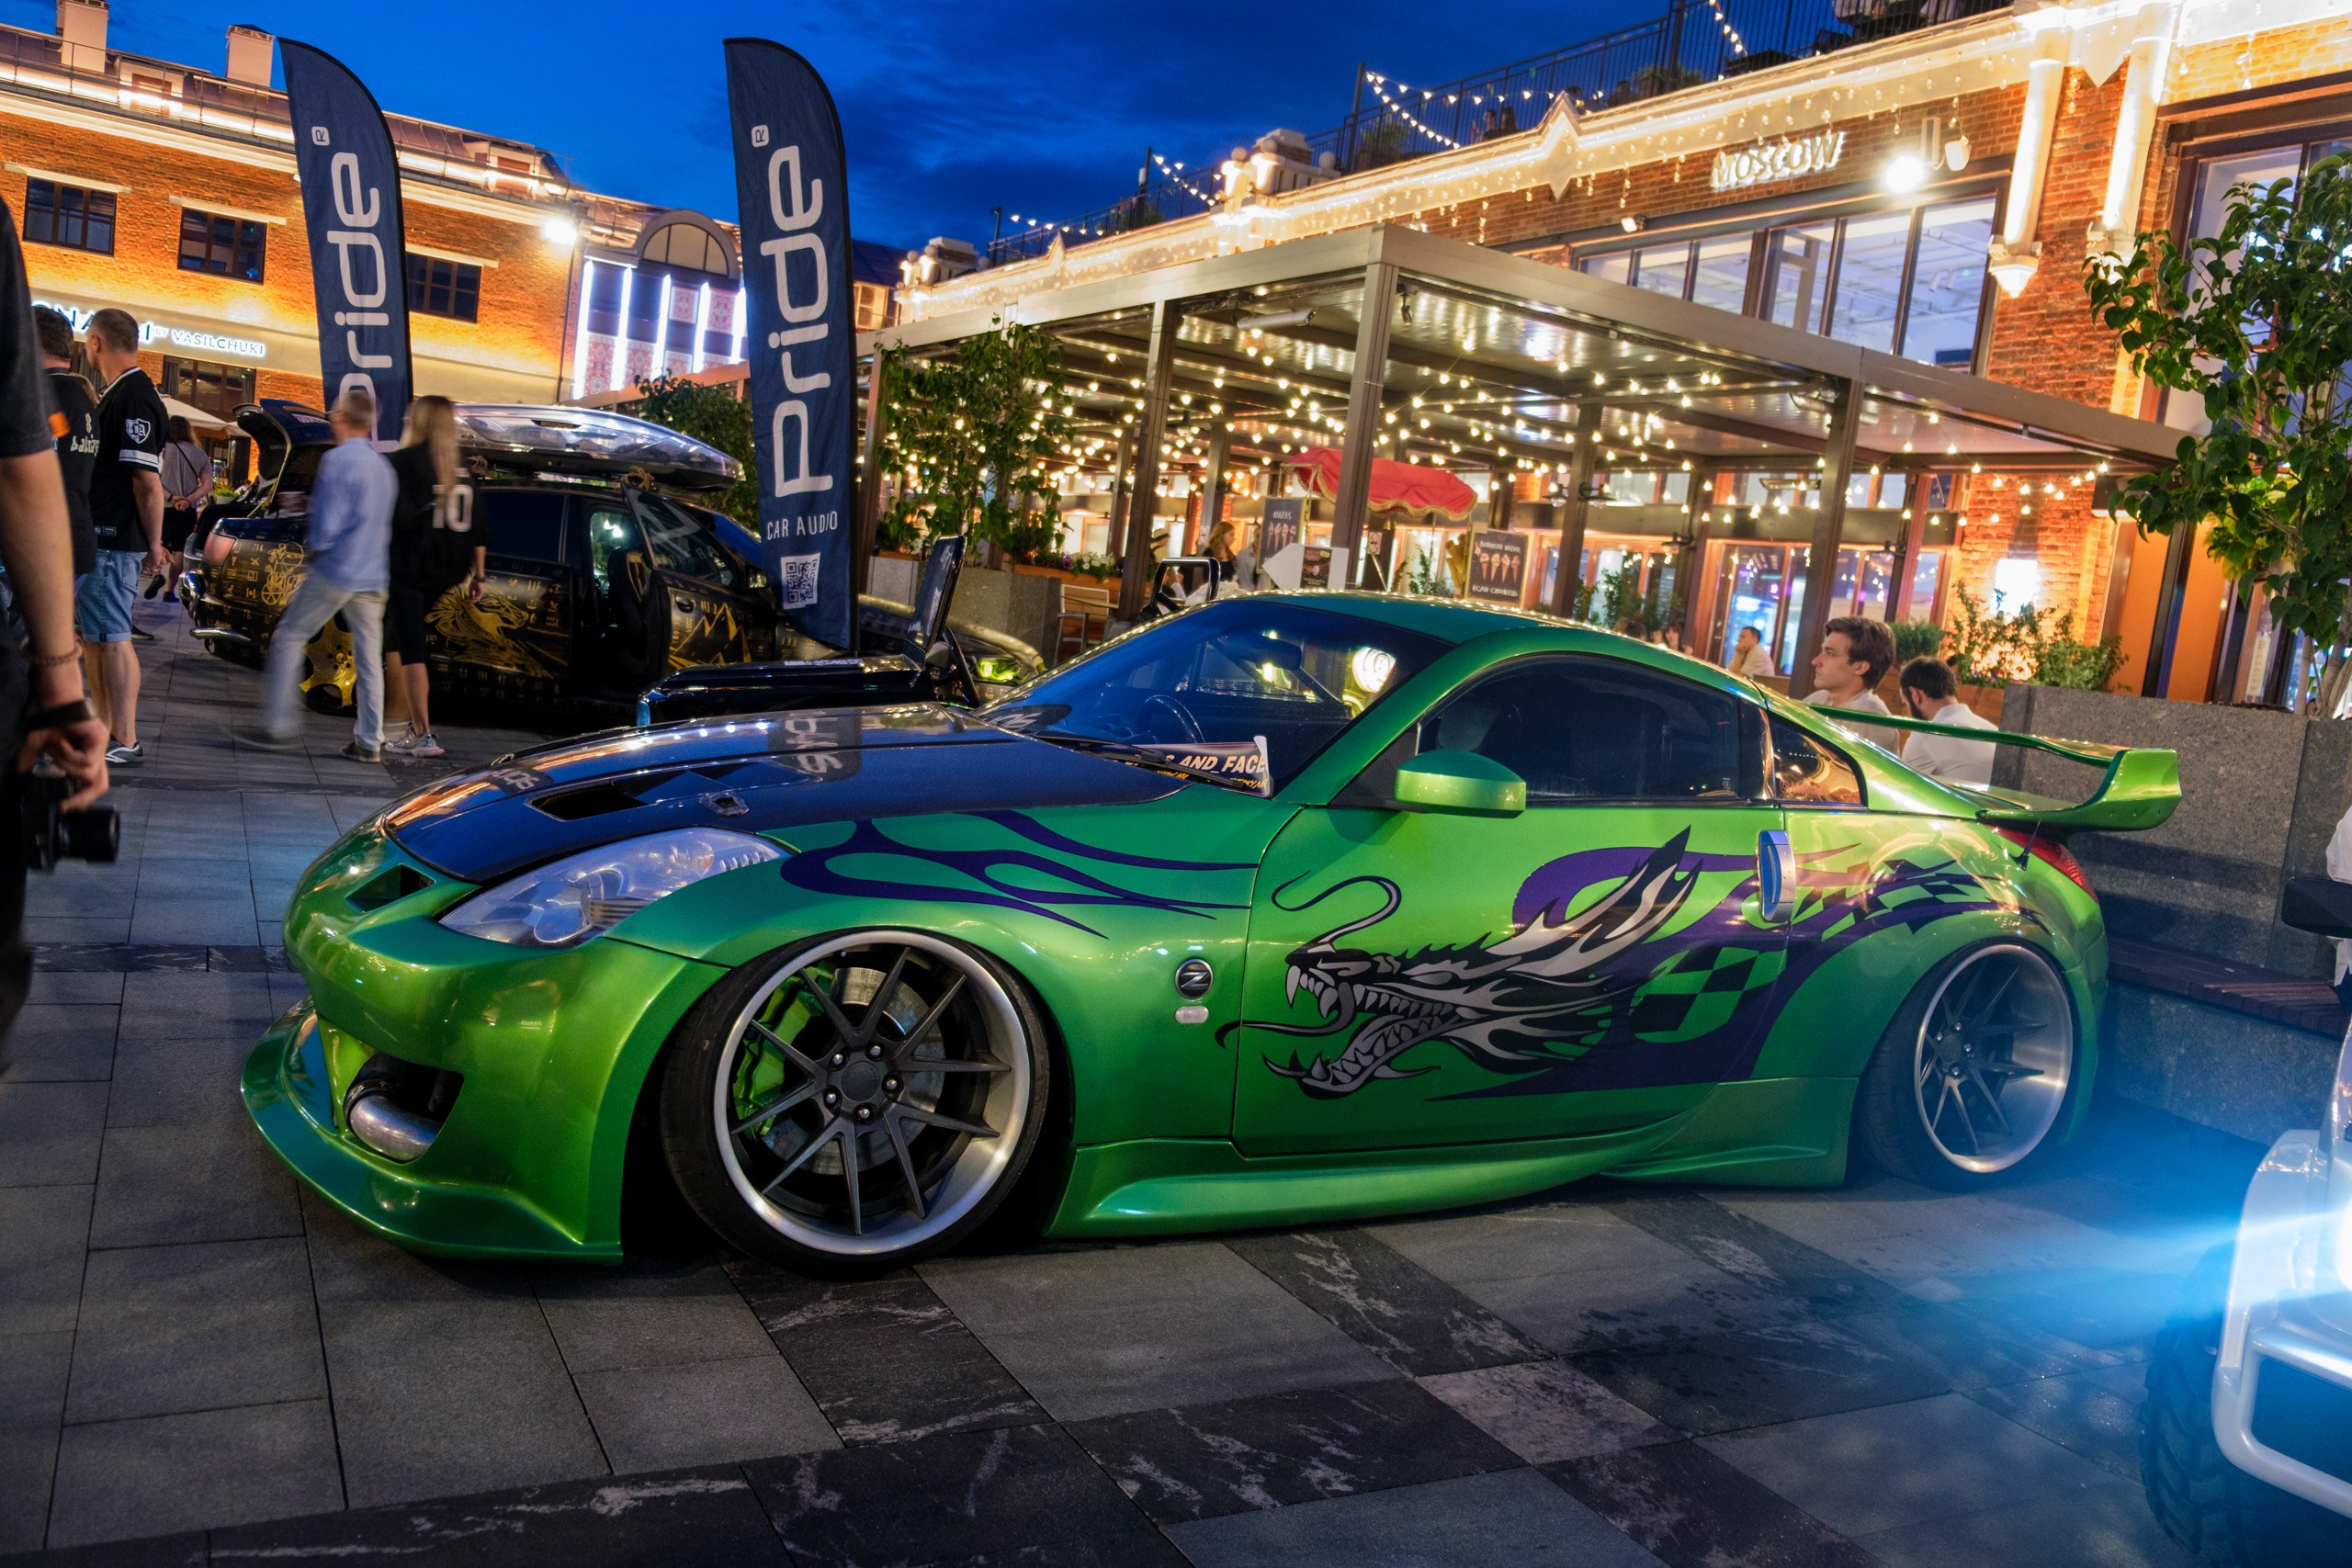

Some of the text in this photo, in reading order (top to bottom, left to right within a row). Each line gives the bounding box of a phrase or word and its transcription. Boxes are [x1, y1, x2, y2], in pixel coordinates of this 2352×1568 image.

[1711, 132, 1844, 189] MOSCOW
[172, 330, 265, 355] VASILCHUKI
[760, 144, 833, 498] Pride
[767, 511, 838, 540] CAR AUDIO
